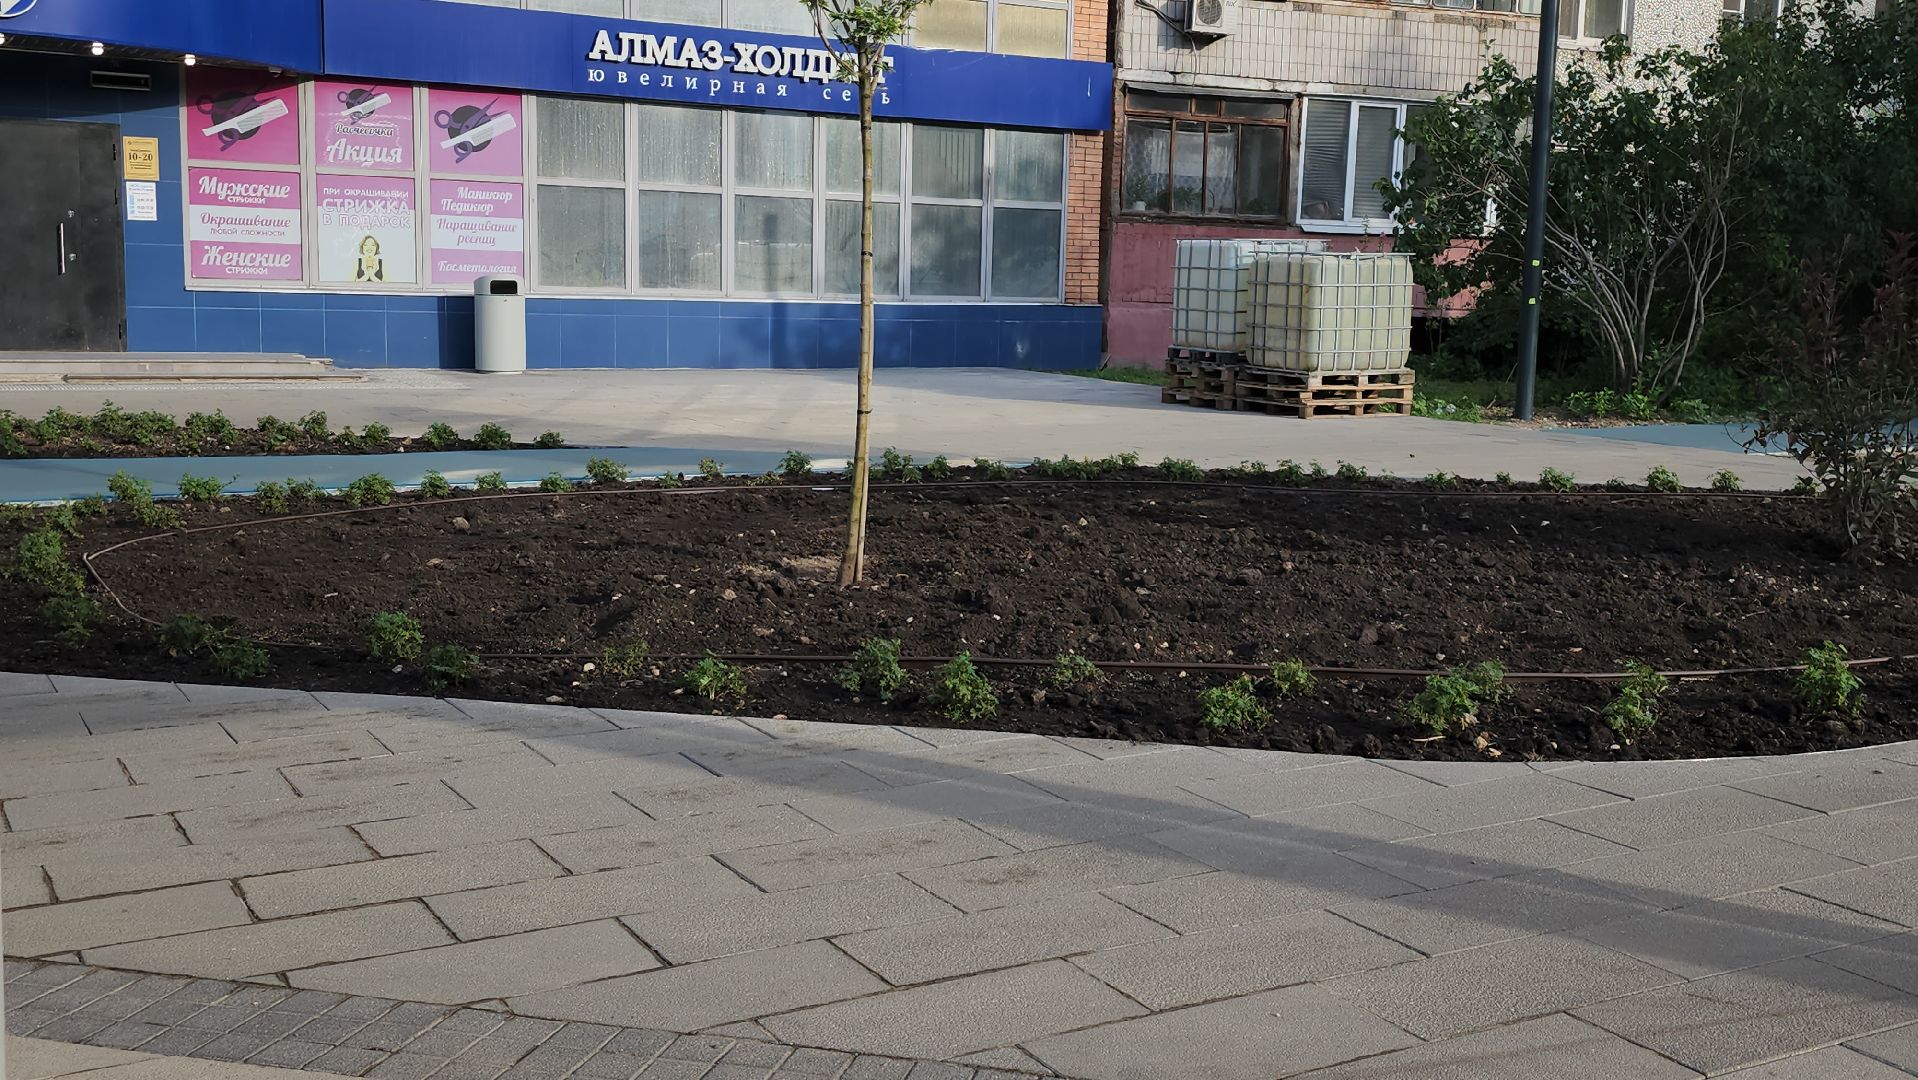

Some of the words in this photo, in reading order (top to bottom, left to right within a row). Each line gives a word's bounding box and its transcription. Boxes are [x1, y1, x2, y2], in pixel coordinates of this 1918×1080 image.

[588, 30, 894, 83] АЛМАЗ-ХОЛДИГ
[587, 69, 787, 97] ювелирная
[823, 88, 890, 104] сеь
[335, 122, 394, 137] Расчесочка
[128, 152, 153, 161] 10-20
[326, 138, 402, 167] Акция
[199, 176, 290, 200] Мужские
[457, 186, 512, 204] Маникюр
[227, 196, 266, 205] СТРИЖКИ
[322, 198, 410, 215] СТРИЖКА
[441, 198, 494, 216] Педикюр
[201, 212, 290, 228] Окрашивание
[323, 214, 332, 225] В
[339, 214, 411, 229] ПОДАРОК
[437, 218, 517, 233] Наращивание
[210, 227, 237, 235] ЛЮБОЙ
[457, 234, 495, 246] ресниц
[202, 245, 291, 268] Женские
[225, 266, 268, 275] СТРИЖКИ
[438, 260, 517, 274] Косметология
